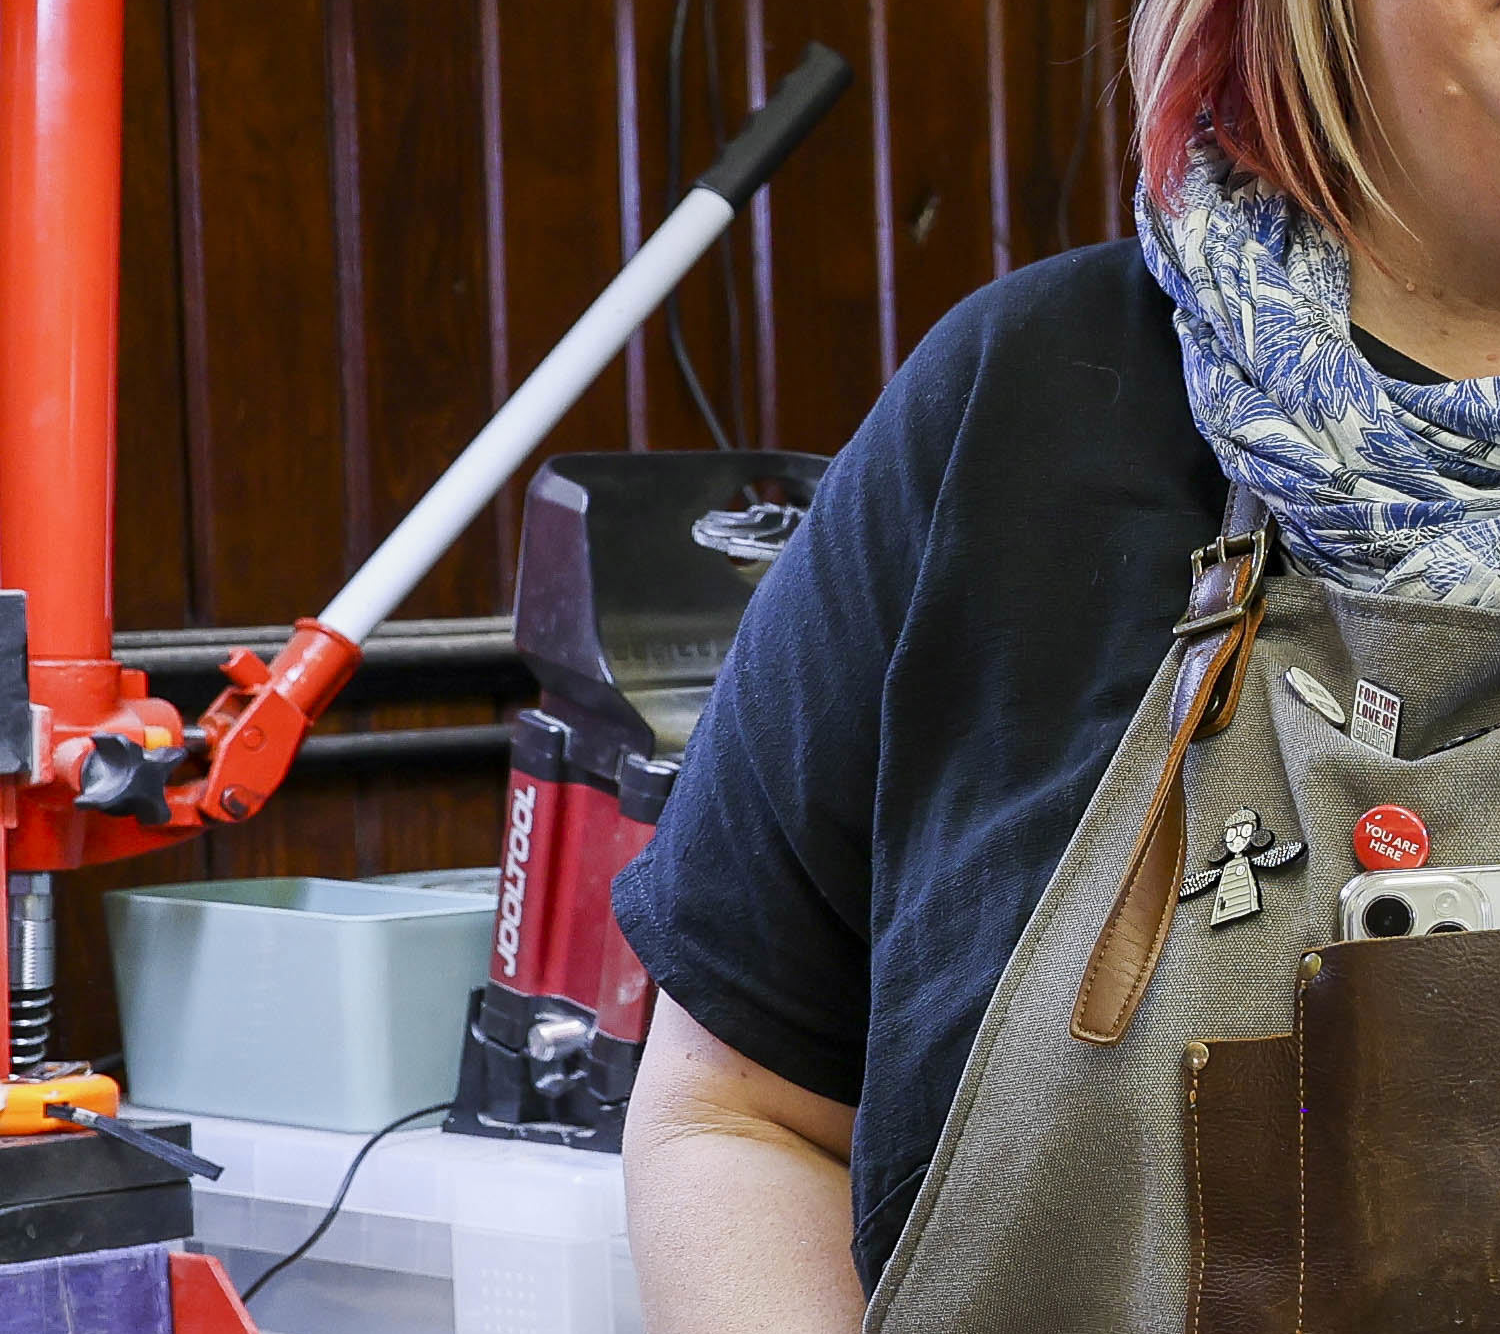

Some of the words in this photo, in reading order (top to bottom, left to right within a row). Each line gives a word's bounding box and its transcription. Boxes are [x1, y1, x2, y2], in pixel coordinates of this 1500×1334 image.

[1355, 700, 1382, 725] LOVE
[1381, 715, 1395, 732] OF
[1359, 684, 1378, 707] FOR
[1378, 692, 1399, 716] THE
[1353, 716, 1394, 756] CRAFT
[1365, 821, 1393, 843] YOU
[1391, 836, 1420, 856] ARE
[1369, 838, 1404, 862] HERE
[497, 785, 536, 978] JOOLTOOL
